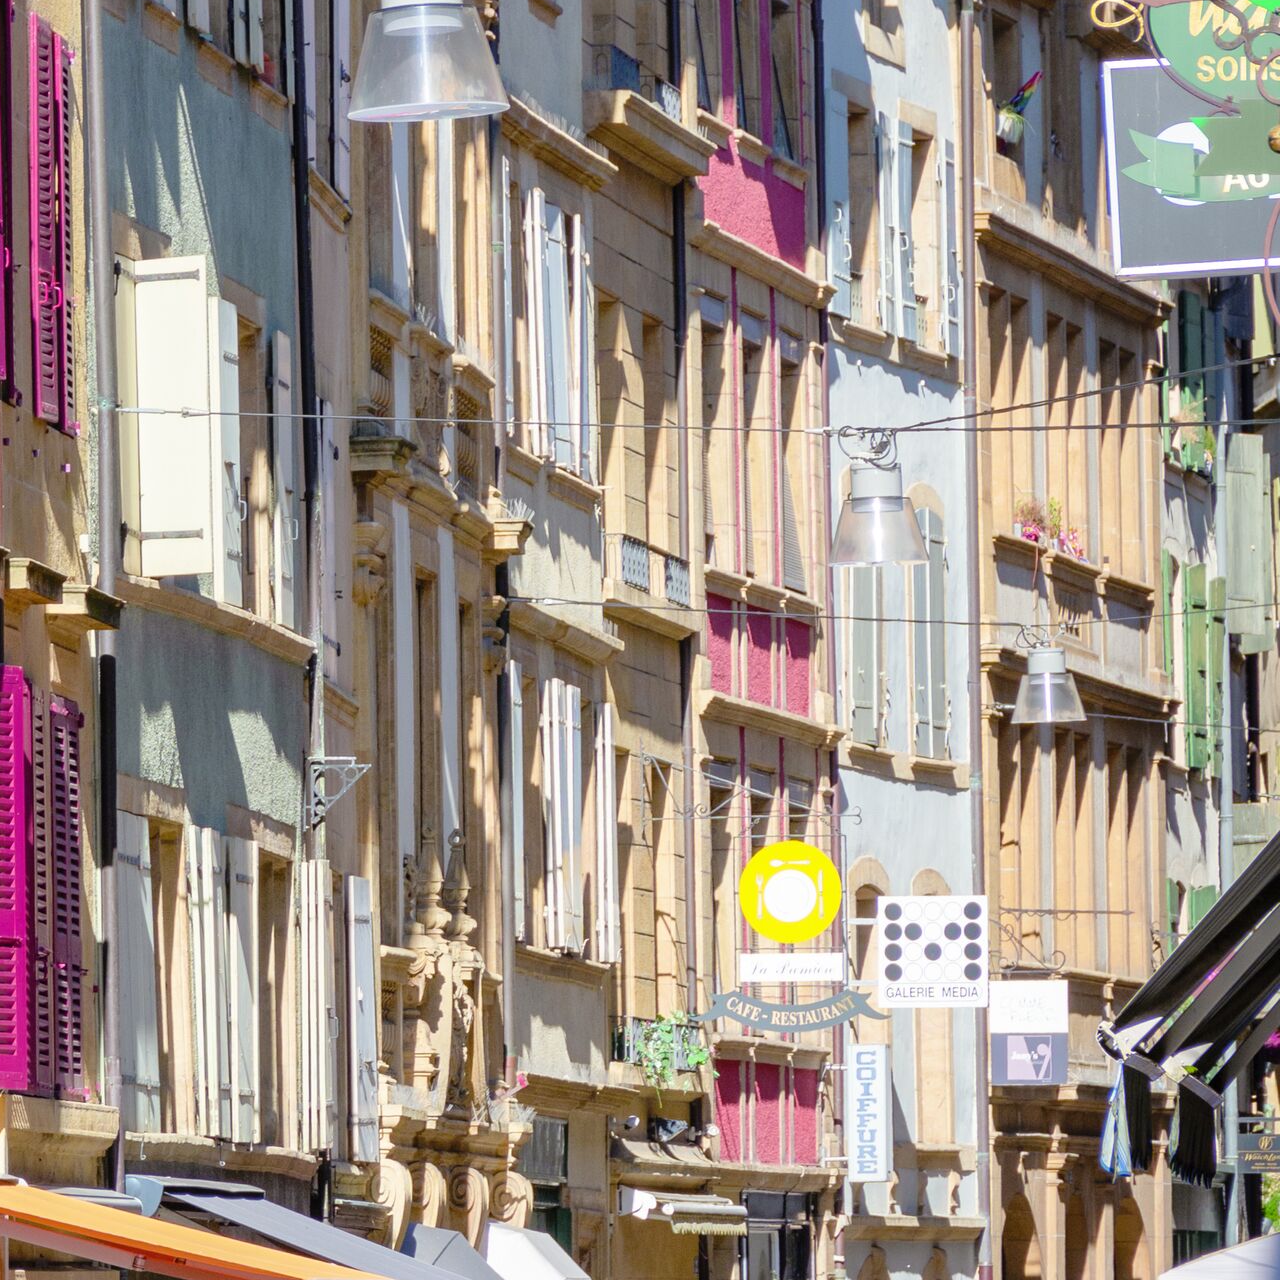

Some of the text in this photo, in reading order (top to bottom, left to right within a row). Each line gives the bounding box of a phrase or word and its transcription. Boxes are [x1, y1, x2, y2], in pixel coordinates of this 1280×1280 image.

[886, 986, 979, 998] GALERIE MEDIA
[726, 997, 762, 1021] CAFE
[771, 996, 856, 1026] RESTAURANT
[856, 1051, 877, 1174] COIFFURE
